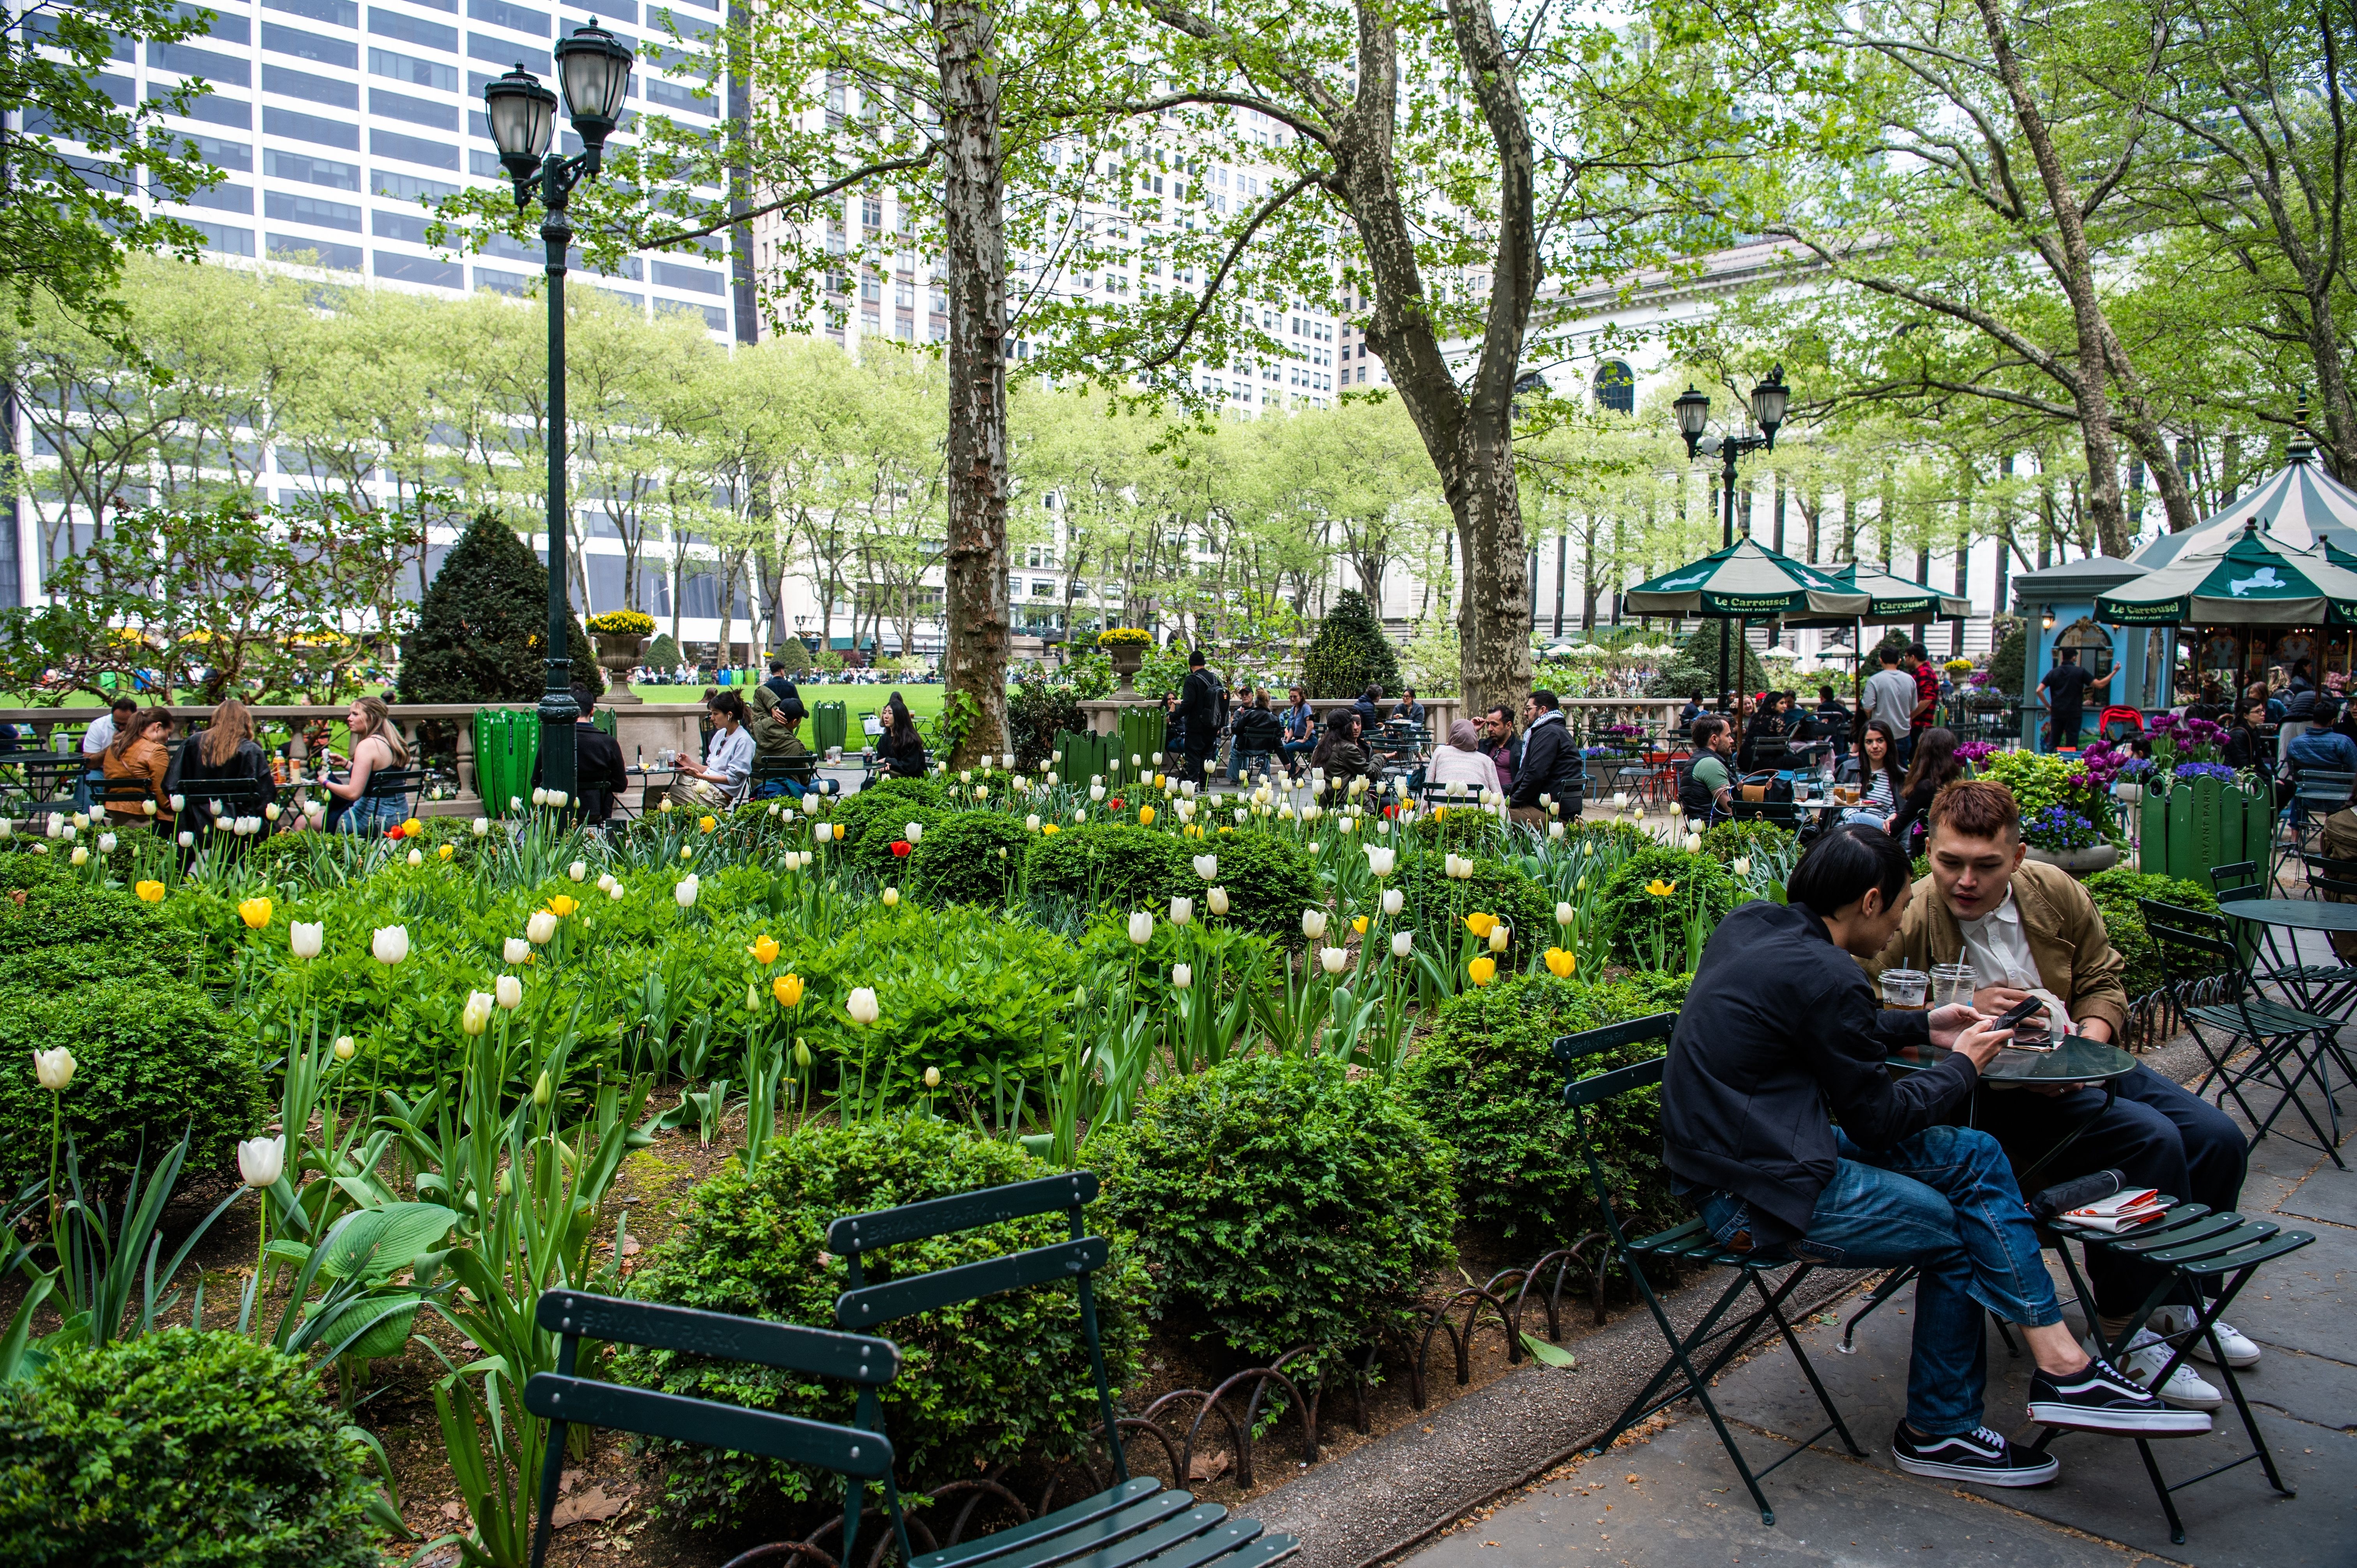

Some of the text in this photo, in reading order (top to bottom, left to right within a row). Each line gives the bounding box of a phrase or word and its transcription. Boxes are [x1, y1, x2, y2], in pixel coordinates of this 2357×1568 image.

[1714, 597, 1790, 607] Le Carrousel
[1880, 599, 1928, 609] Carrousel
[2109, 602, 2179, 614] Le Carrousel
[2339, 605, 2351, 616] Le
[1571, 1030, 1627, 1053] BRYANT PARK
[868, 1202, 989, 1241] BRYANT PARK
[580, 1310, 740, 1351] BRYANT PARK
